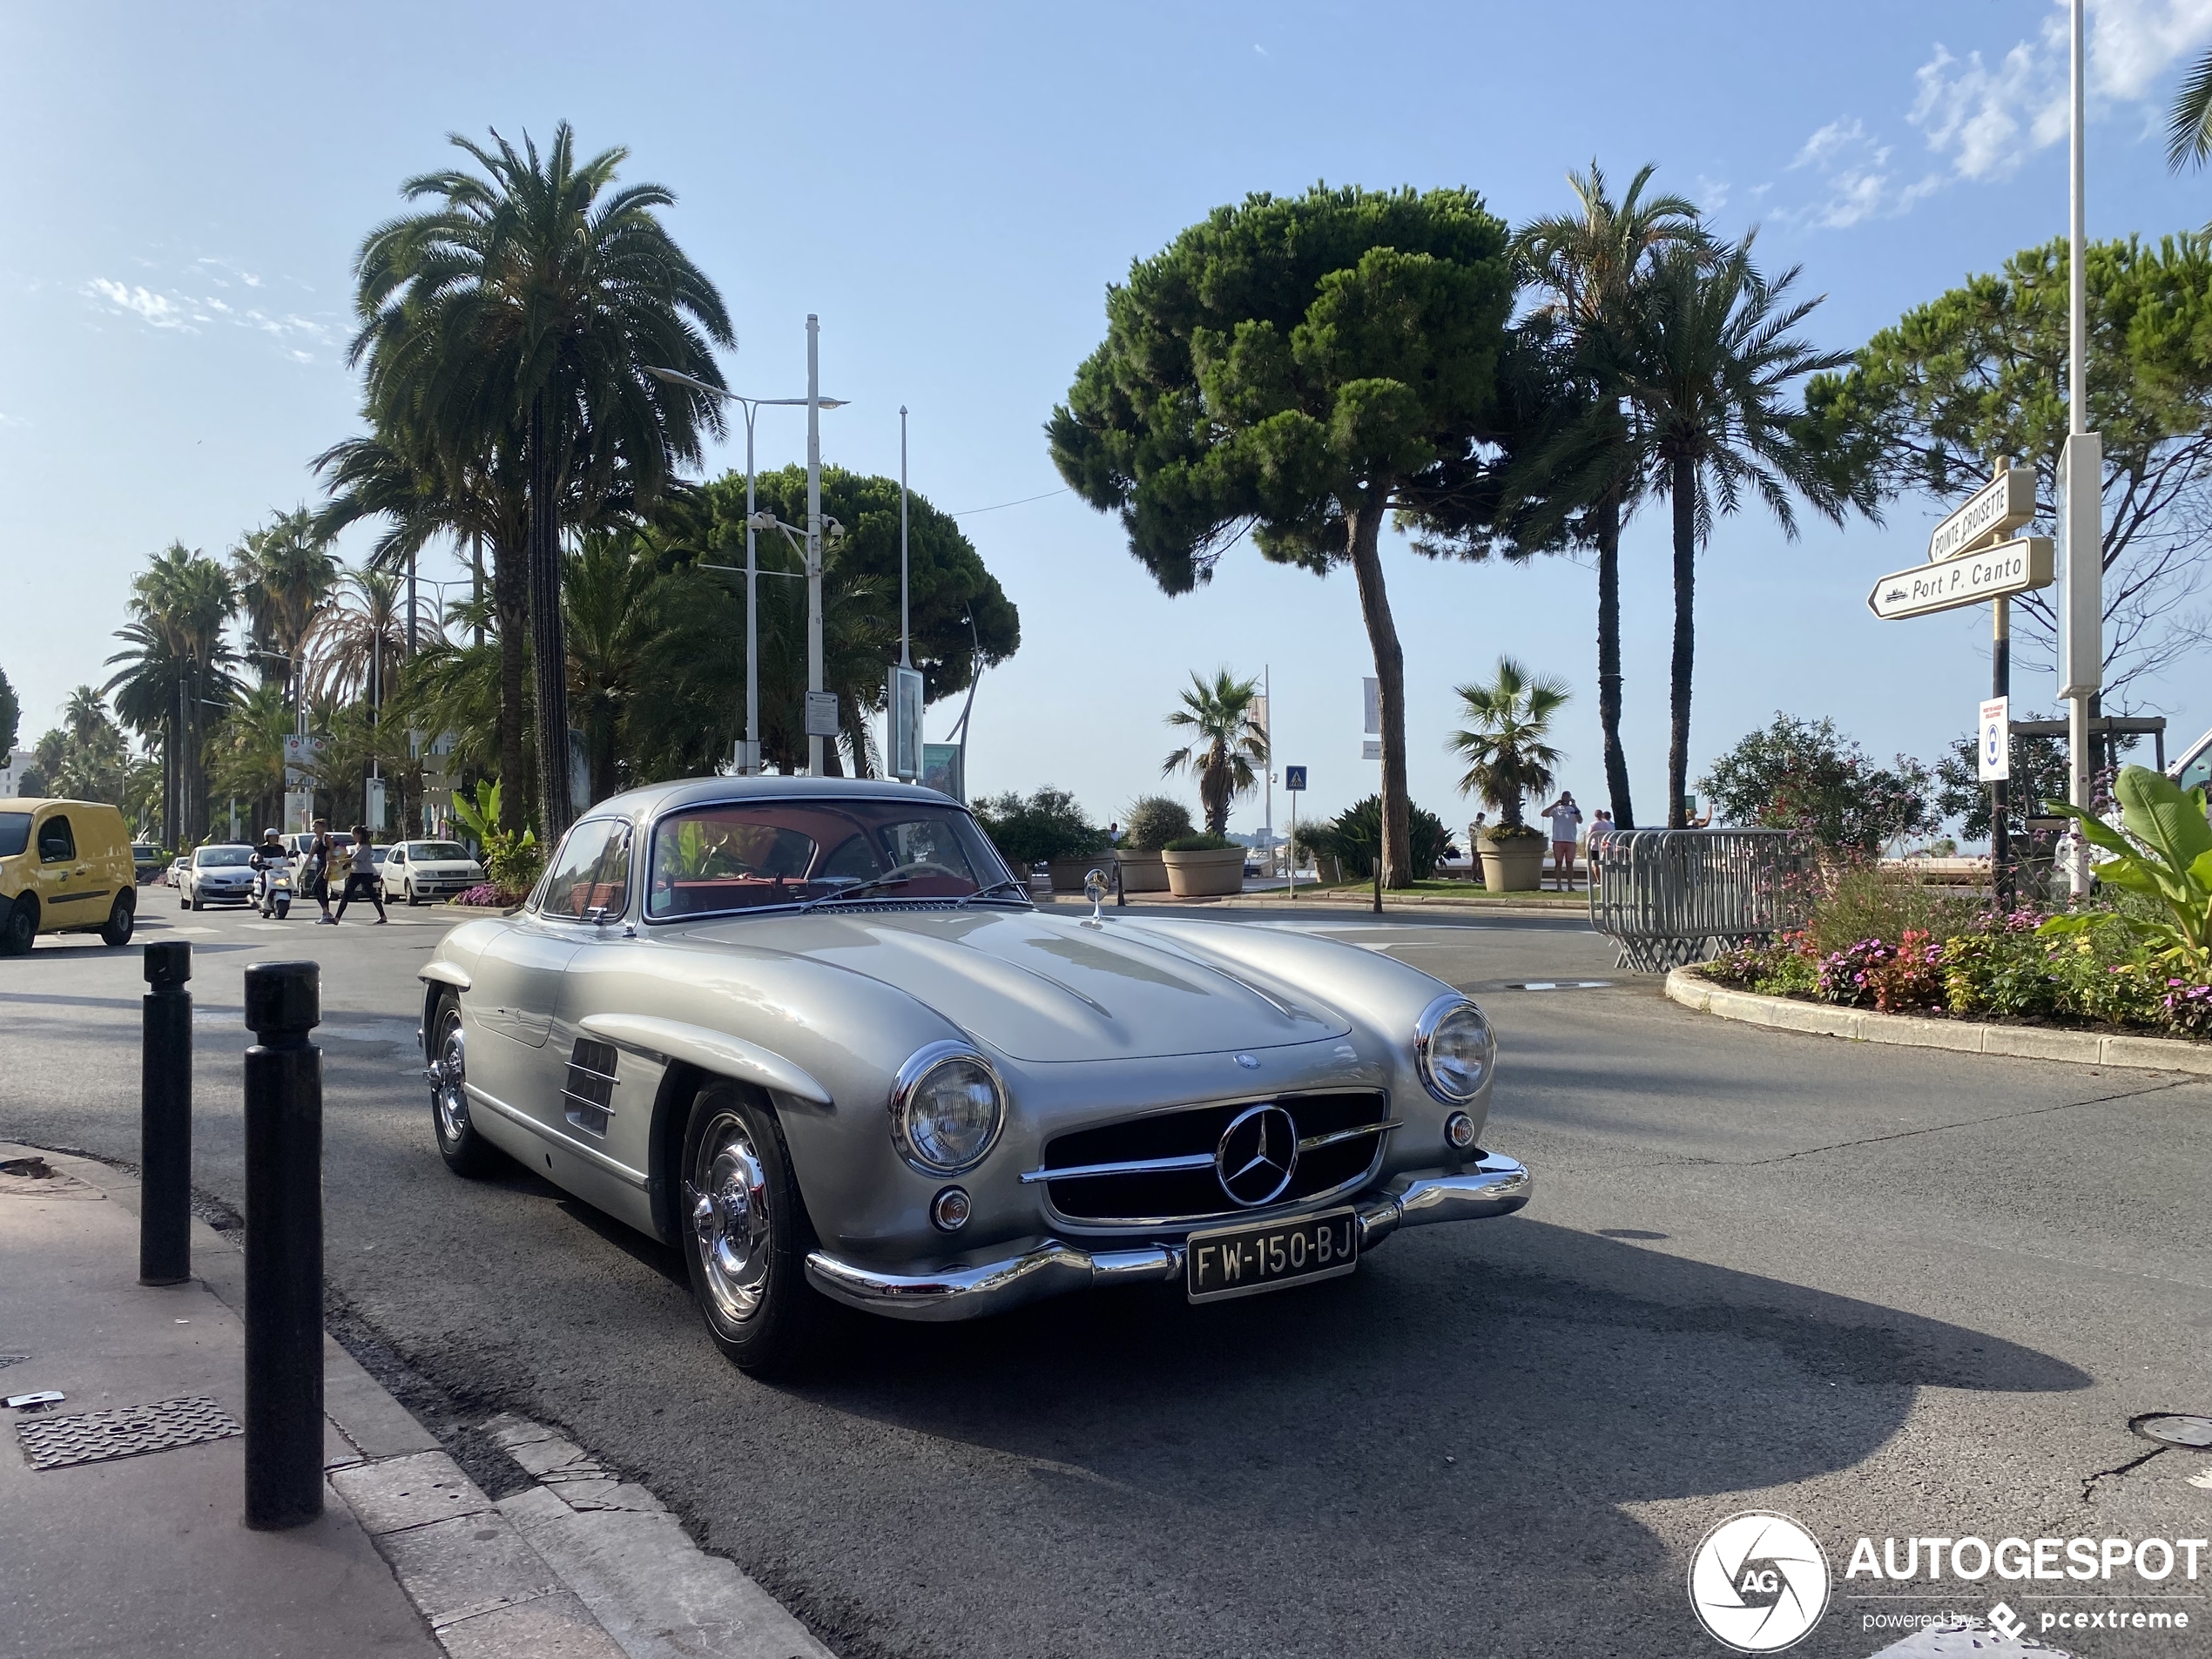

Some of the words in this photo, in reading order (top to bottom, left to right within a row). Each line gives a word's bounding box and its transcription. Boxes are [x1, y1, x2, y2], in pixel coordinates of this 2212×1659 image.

[1935, 522, 1959, 557] POINTE
[1963, 486, 2005, 534] CROISETTE
[1913, 577, 1943, 599] Port
[1951, 570, 1965, 590] P.
[1973, 558, 2021, 584] Canto
[1197, 1221, 1351, 1286] FW-150-BJ
